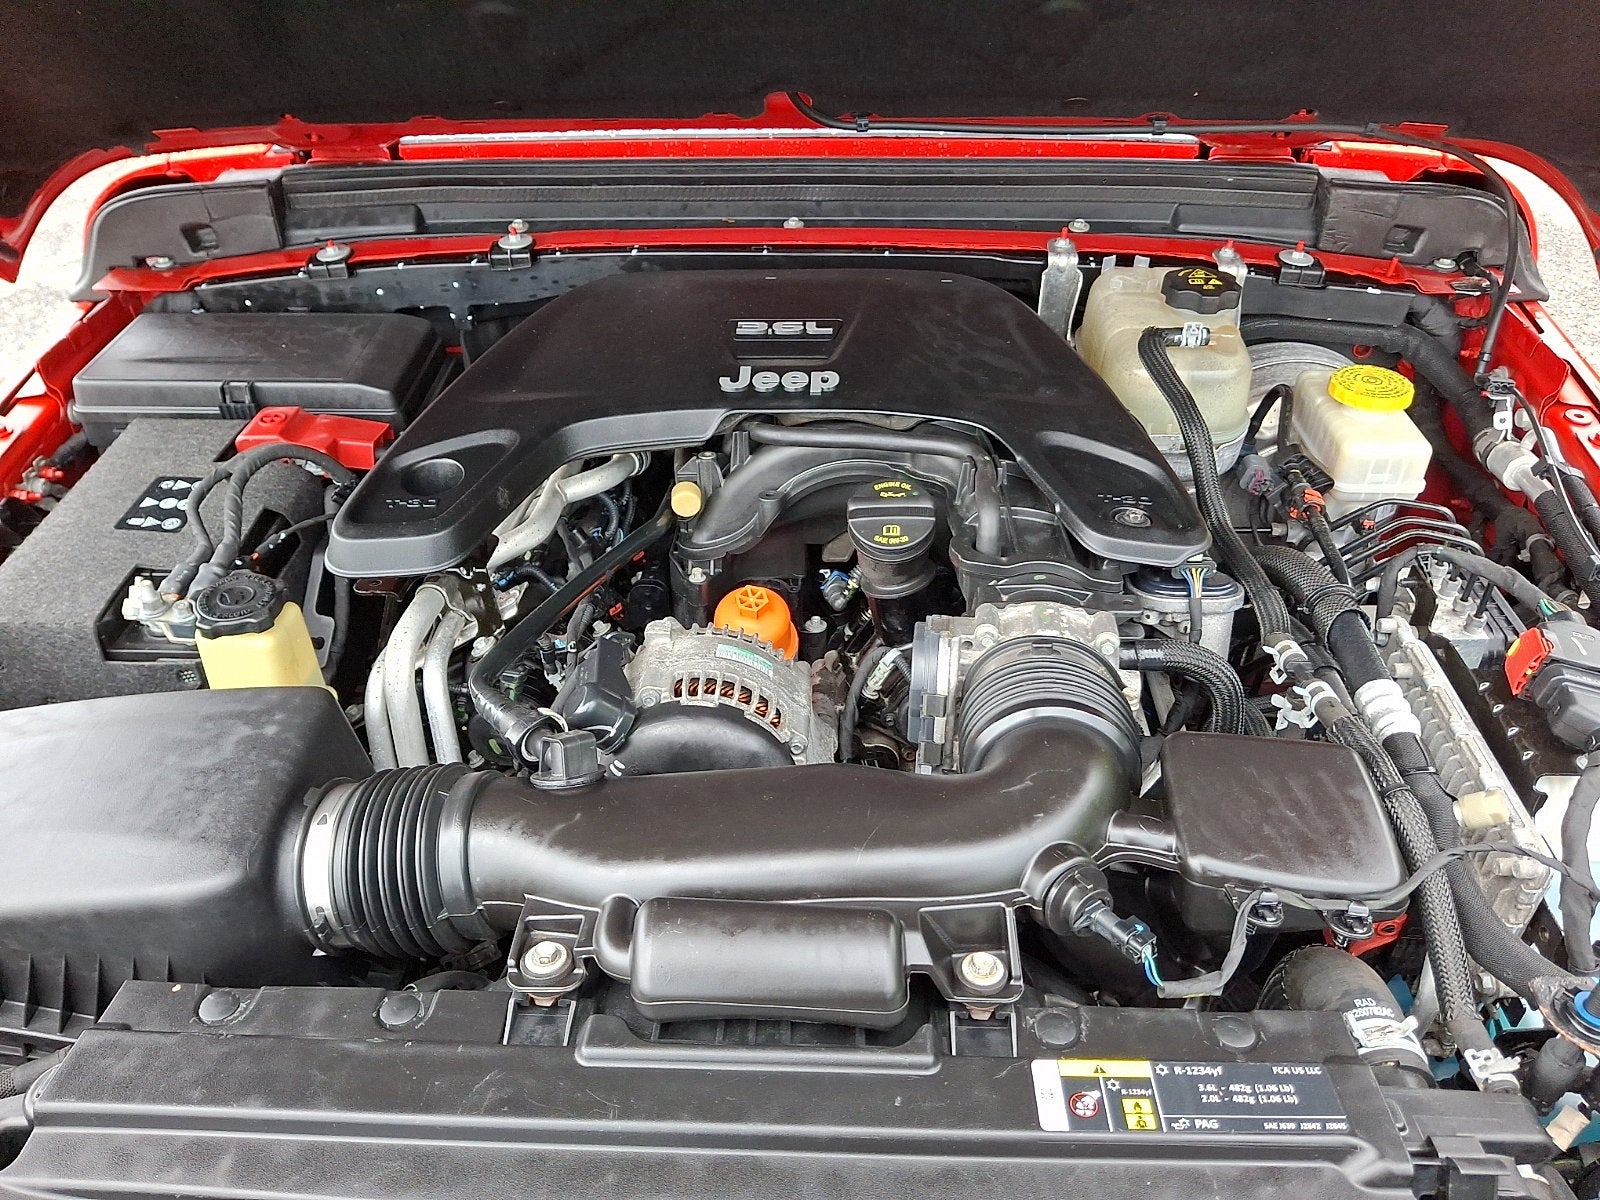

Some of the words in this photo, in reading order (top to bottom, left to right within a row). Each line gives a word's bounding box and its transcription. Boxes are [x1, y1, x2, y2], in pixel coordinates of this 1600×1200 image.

[735, 321, 833, 335] 3.6L
[719, 366, 840, 395] Jeep
[873, 481, 901, 491] ENGINE
[901, 482, 912, 491] OIL
[1353, 997, 1377, 1008] RAD
[1174, 1066, 1223, 1077] R-1234yf
[1272, 1066, 1290, 1075] FCA
[1291, 1066, 1305, 1075] US
[1305, 1066, 1322, 1075] LLC
[1197, 1083, 1218, 1092] 3.6L
[1200, 1094, 1222, 1103] 2.0L
[1194, 1119, 1219, 1129] PAG
